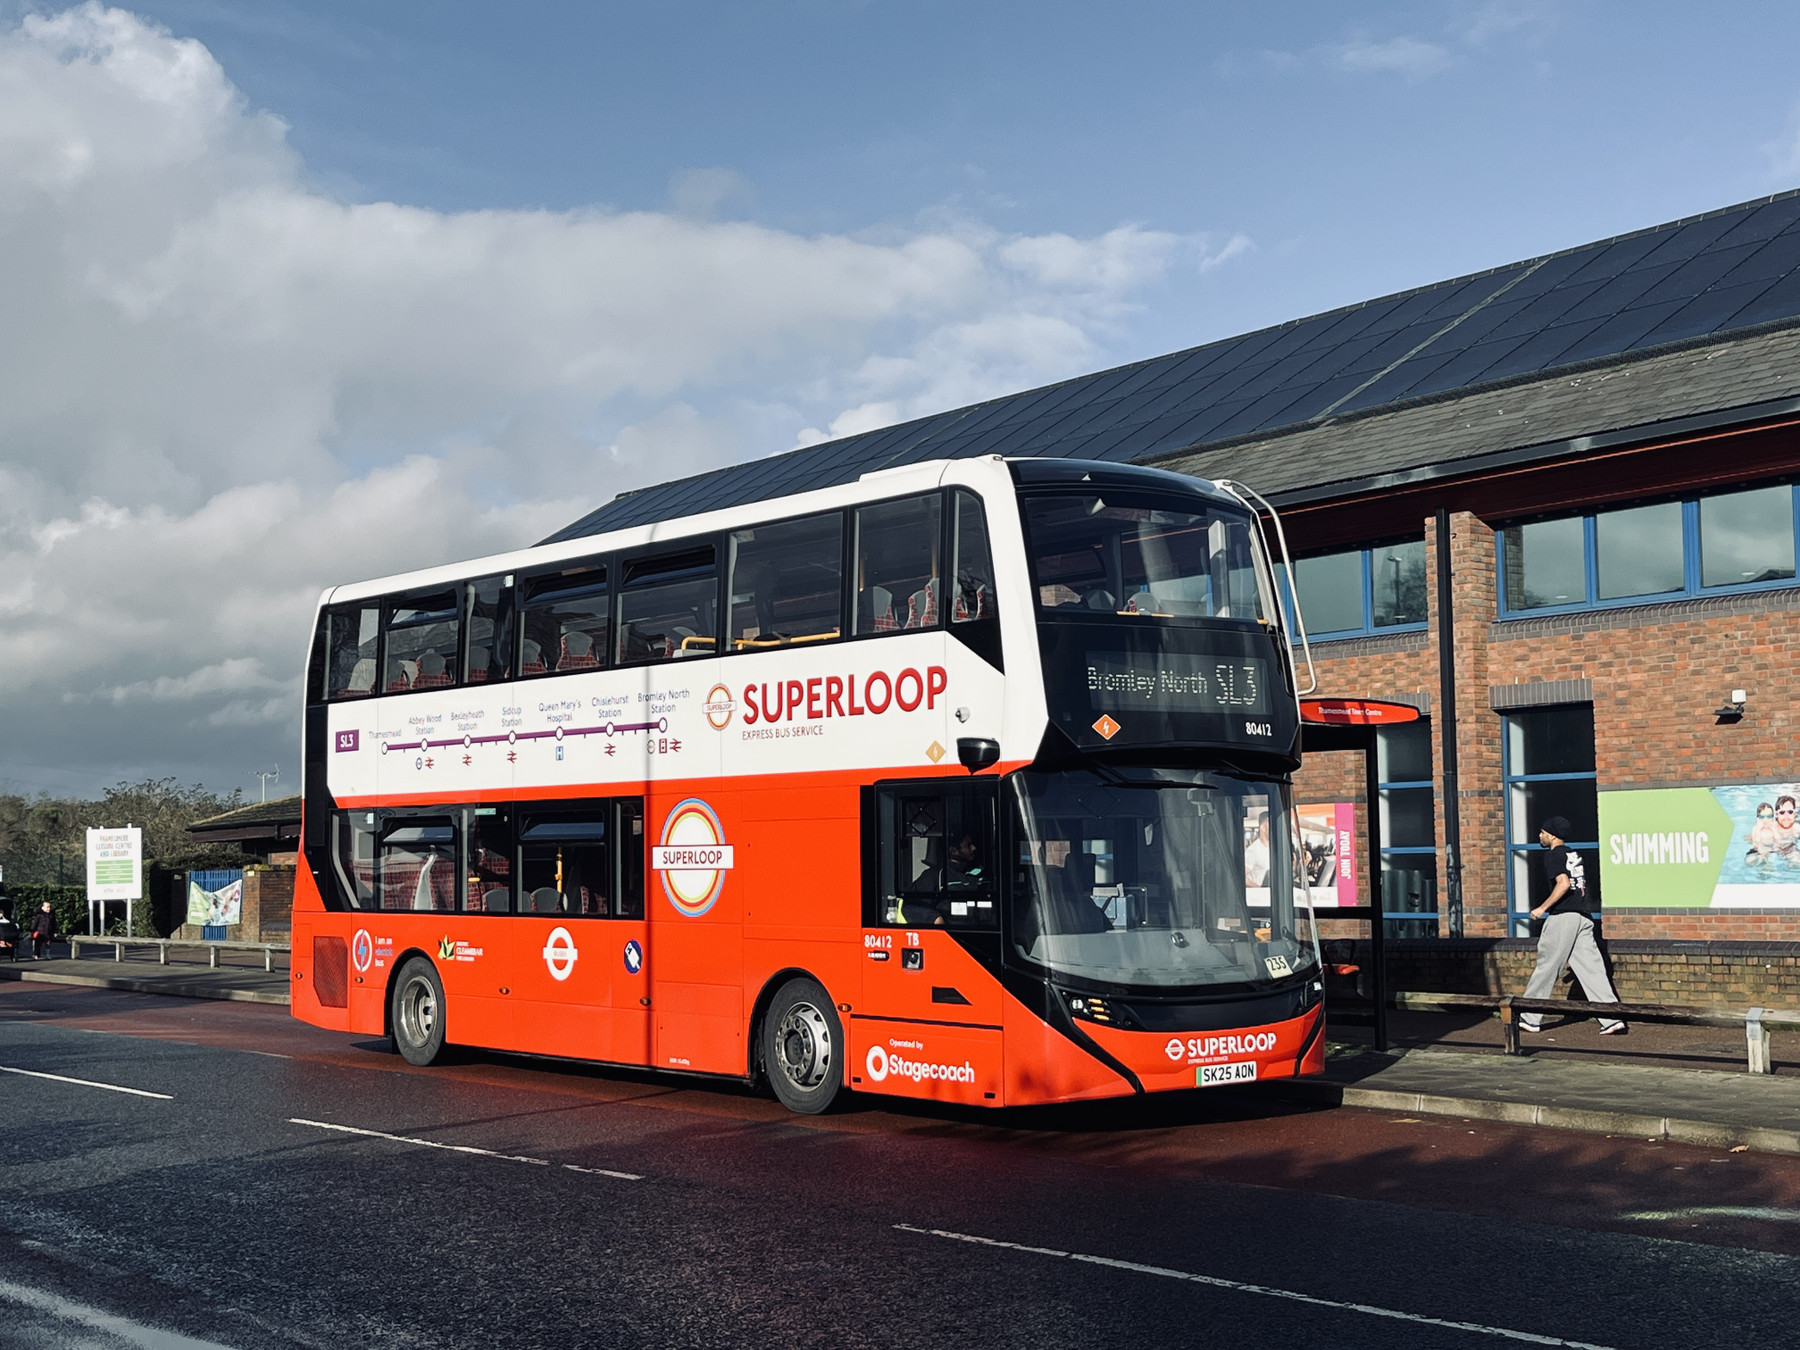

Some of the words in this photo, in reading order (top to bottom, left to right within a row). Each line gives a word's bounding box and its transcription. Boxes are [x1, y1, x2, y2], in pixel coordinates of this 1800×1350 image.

[1087, 666, 1156, 698] Bromley
[1161, 670, 1208, 694] North
[1215, 664, 1257, 705] SL3
[592, 695, 629, 707] Chislehurst
[638, 692, 667, 703] Bromley
[669, 688, 690, 699] North
[742, 665, 948, 725] SUPERLOOP
[502, 706, 522, 717] Sidcup
[539, 702, 559, 712] Queen
[561, 699, 582, 711] Mary's
[651, 703, 676, 714] Station
[547, 713, 573, 724] Hospital
[599, 708, 622, 719] Station
[458, 722, 478, 731] Station
[502, 717, 522, 727] Station
[1245, 722, 1272, 737] 80412
[742, 728, 774, 740] EXPRESS
[775, 727, 790, 739] BUS
[792, 725, 823, 737] SERVICE
[340, 734, 354, 748] SL3
[1339, 830, 1351, 857] TODAY
[1609, 831, 1709, 865] SWIMMING
[663, 850, 723, 865] SUPERLOOP
[1340, 858, 1351, 880] JOIN
[864, 934, 892, 949] 80412
[905, 931, 920, 947] TB
[1266, 957, 1287, 972] 235
[889, 1038, 915, 1049] Operated
[916, 1040, 924, 1050] by
[1187, 1032, 1277, 1058] SUPERLOOP
[889, 1053, 975, 1083] Stagecoach
[1203, 1066, 1232, 1082] SK25
[1235, 1063, 1254, 1079] AON
